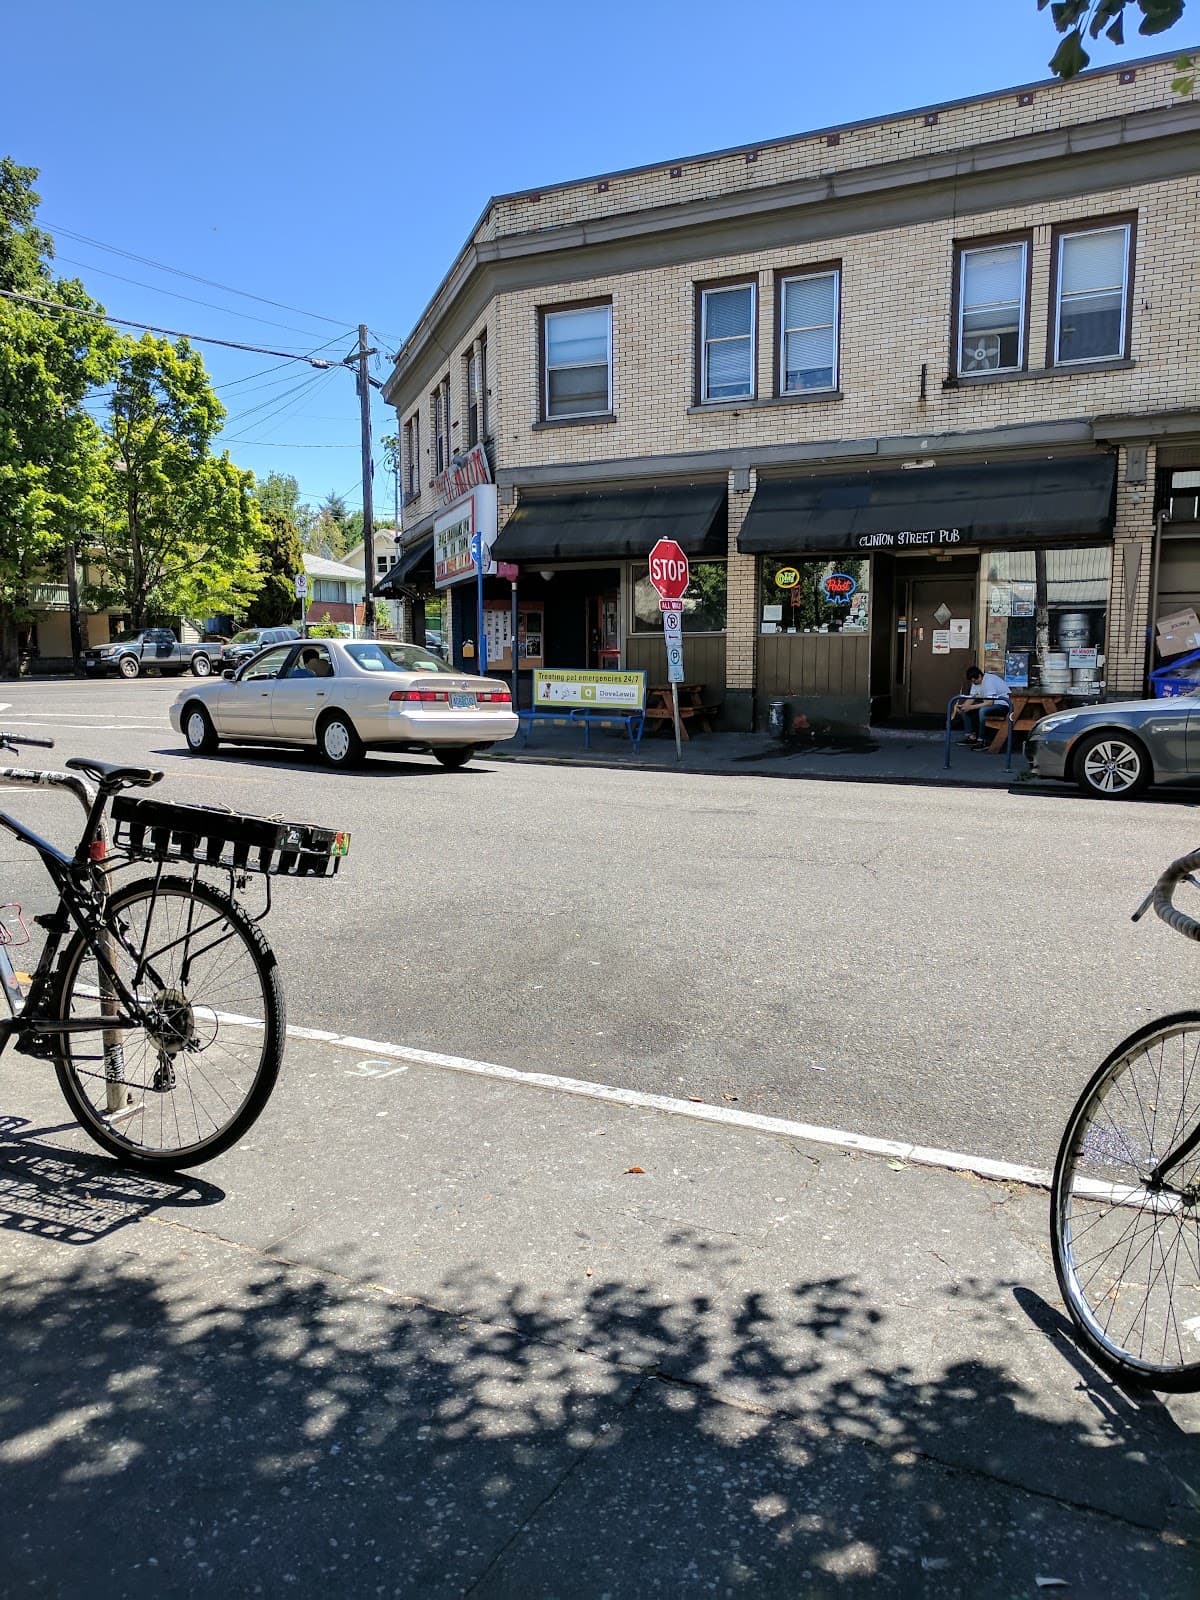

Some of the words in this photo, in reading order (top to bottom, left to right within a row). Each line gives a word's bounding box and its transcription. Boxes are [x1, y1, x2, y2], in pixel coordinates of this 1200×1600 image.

[859, 533, 894, 546] CLINTON
[897, 531, 935, 545] STREET
[939, 528, 960, 543] PUB
[652, 558, 686, 583] STOP
[661, 601, 671, 610] ALL
[538, 672, 565, 682] Treating
[566, 674, 577, 683] pet
[579, 675, 622, 684] emergencies
[623, 676, 639, 684] 24/7
[599, 690, 635, 698] DoveLewis
